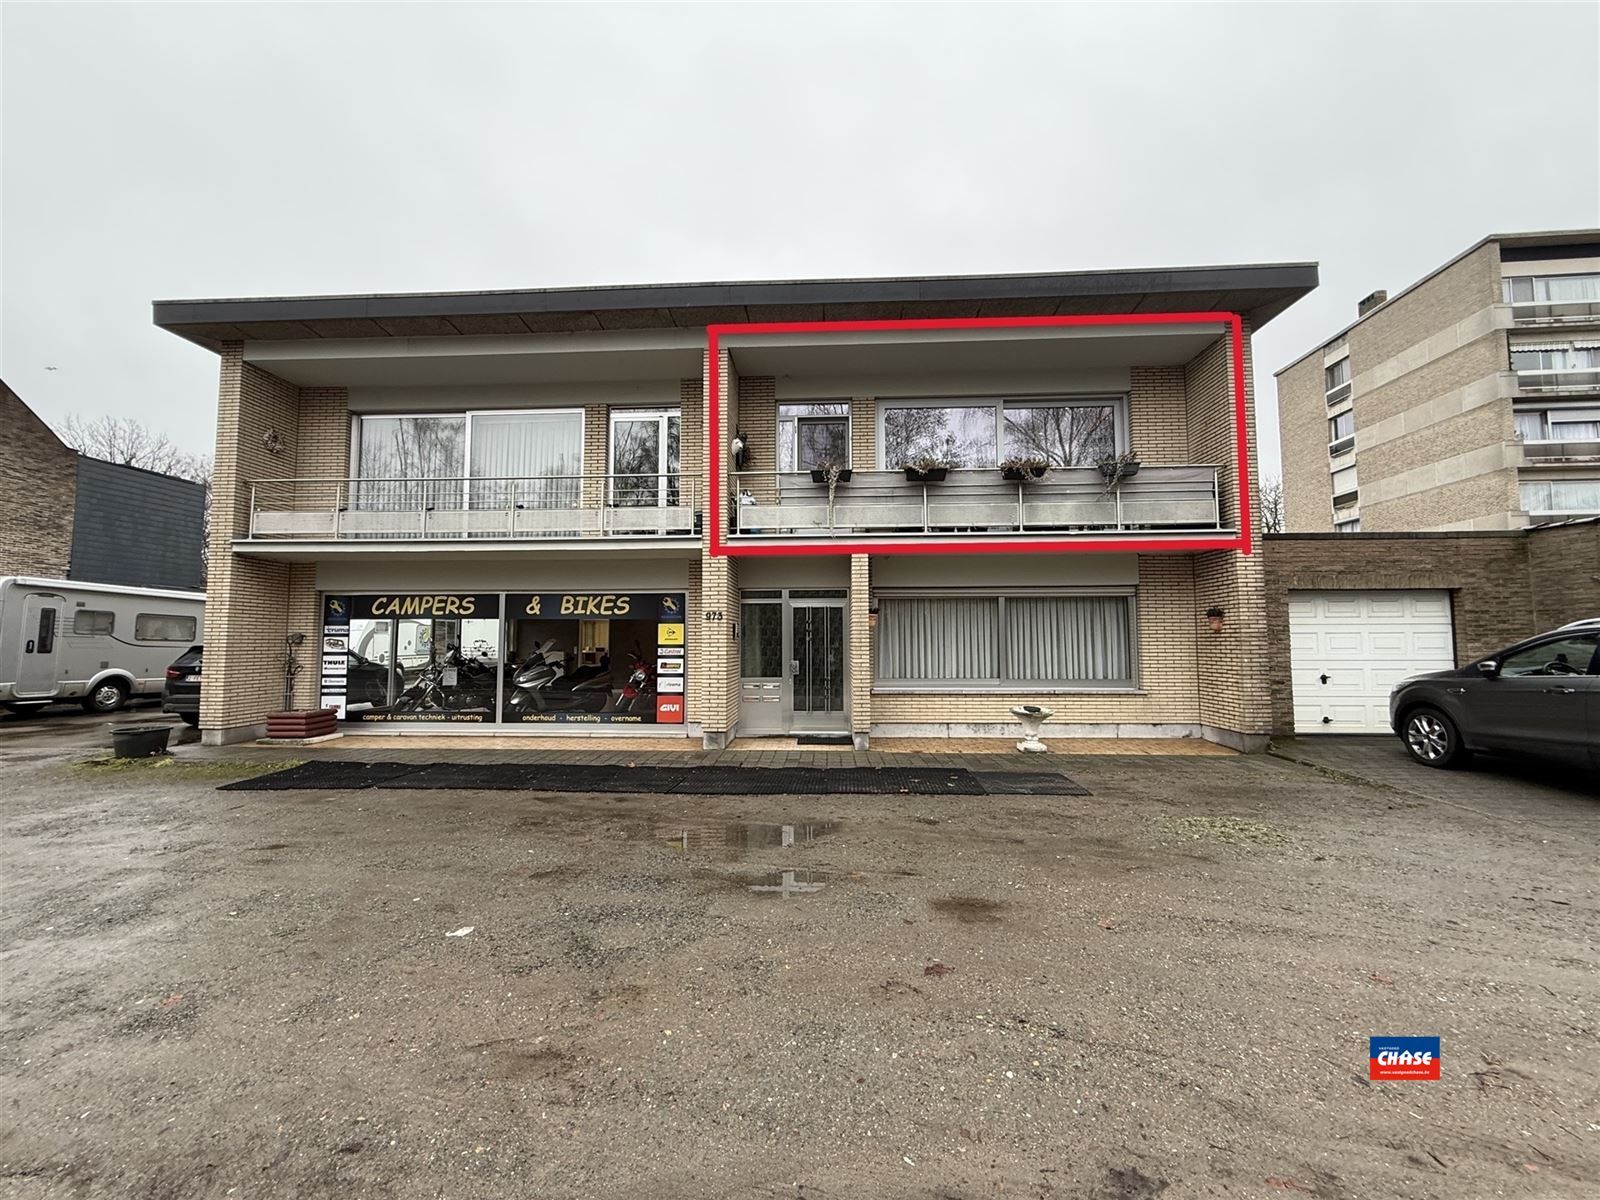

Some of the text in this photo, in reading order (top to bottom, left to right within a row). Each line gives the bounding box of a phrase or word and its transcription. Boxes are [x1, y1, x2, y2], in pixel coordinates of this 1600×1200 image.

[371, 595, 630, 615] CAMPERS & BIKES
[705, 611, 723, 621] 973
[660, 704, 680, 712] GIVI
[362, 714, 386, 723] camper
[386, 713, 392, 721] &
[418, 713, 446, 721] techniek
[451, 713, 483, 723] uitrusting
[566, 713, 601, 723] herstelling
[610, 714, 642, 722] overname
